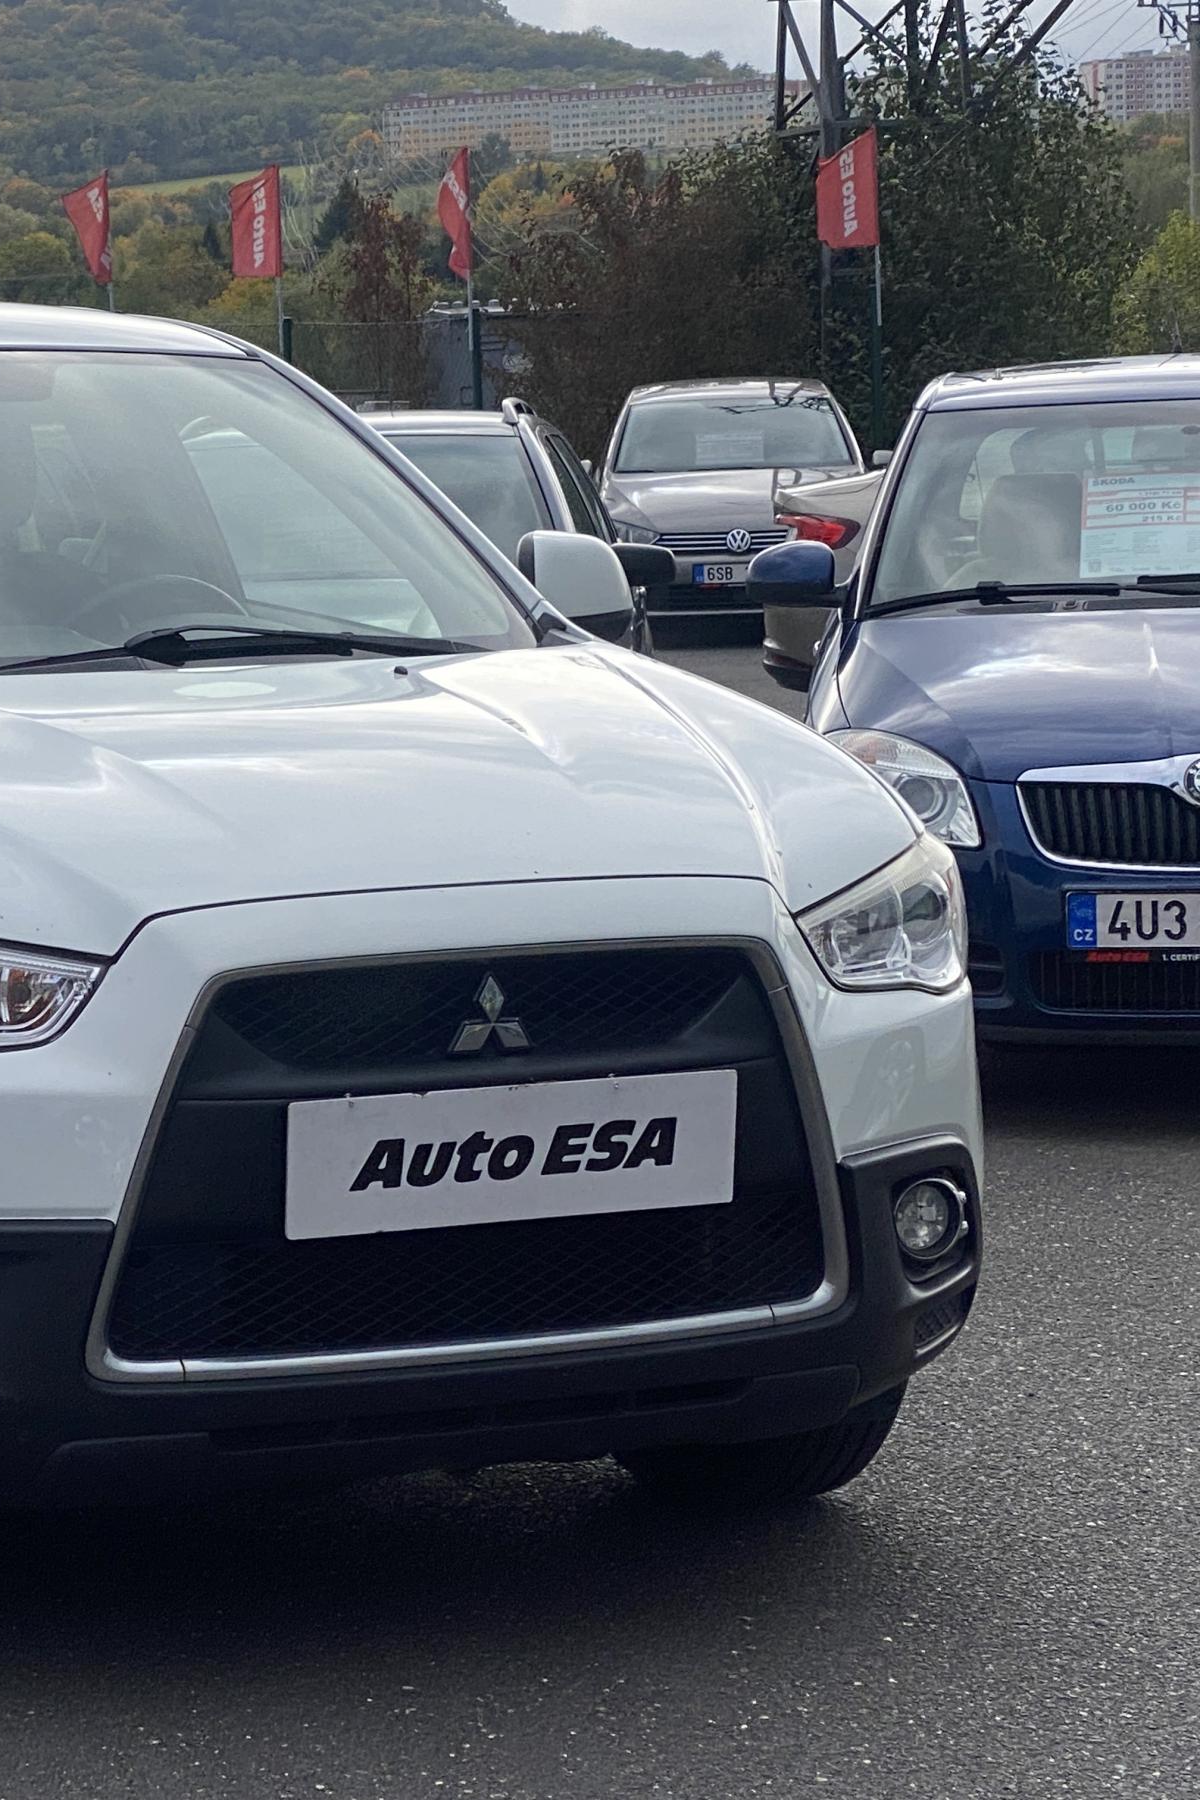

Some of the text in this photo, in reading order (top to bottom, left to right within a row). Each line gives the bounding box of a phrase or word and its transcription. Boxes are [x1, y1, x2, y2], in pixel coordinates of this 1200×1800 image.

[1105, 503, 1124, 513] 60
[1128, 502, 1157, 511] 000
[1108, 900, 1188, 941] 4U3
[1073, 928, 1094, 942] CZ
[349, 1117, 677, 1192] Auto ESA
